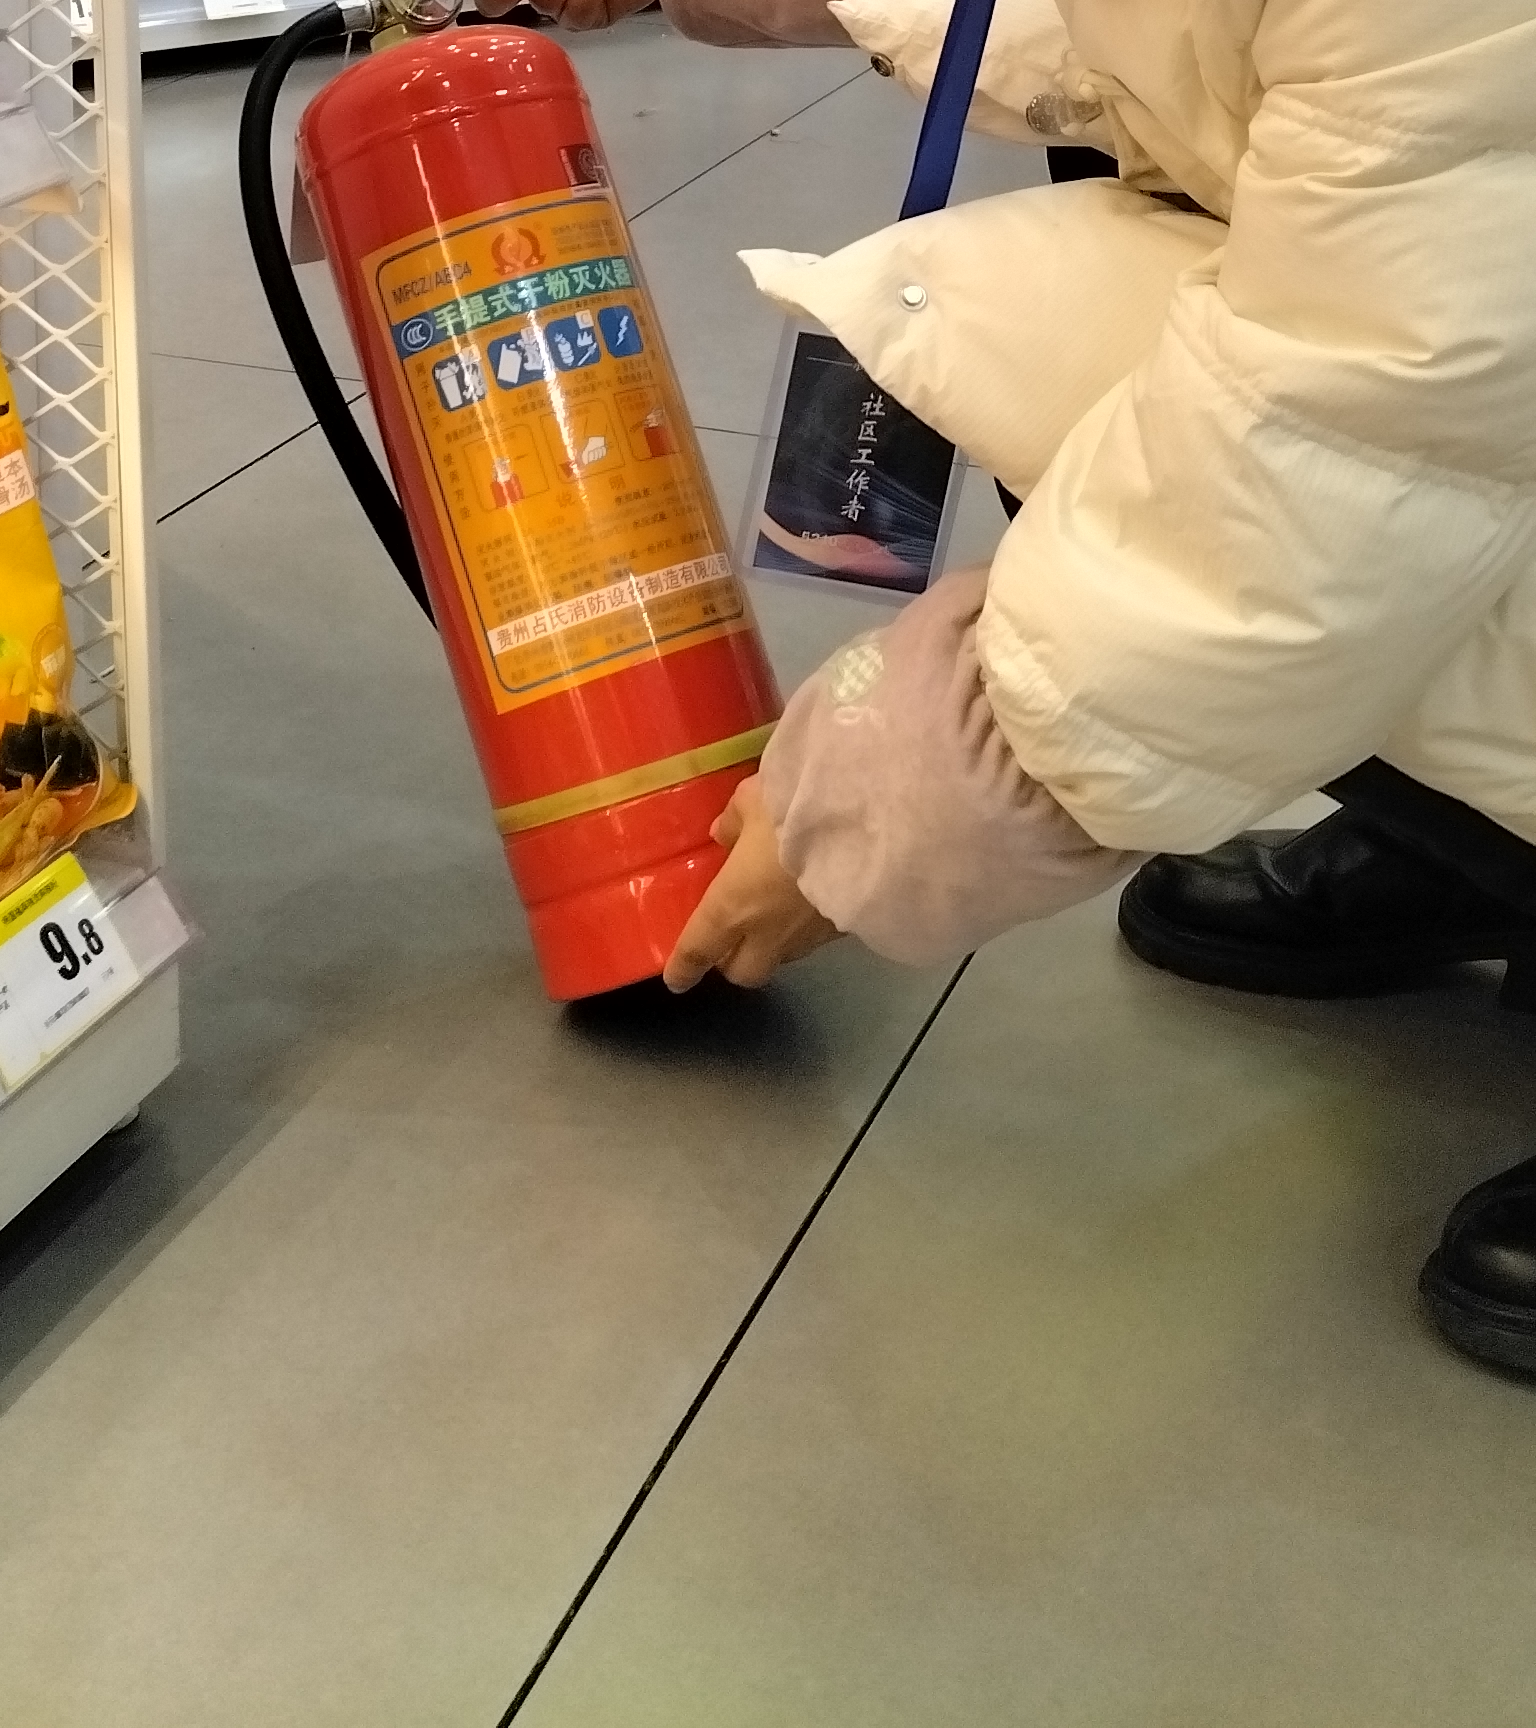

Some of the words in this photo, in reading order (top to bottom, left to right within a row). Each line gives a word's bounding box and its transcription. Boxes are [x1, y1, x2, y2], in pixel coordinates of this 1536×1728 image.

[432, 257, 634, 338] 手提式干粉灭火器
[839, 391, 886, 523] 社区工作者
[39, 918, 104, 981] 9.8
